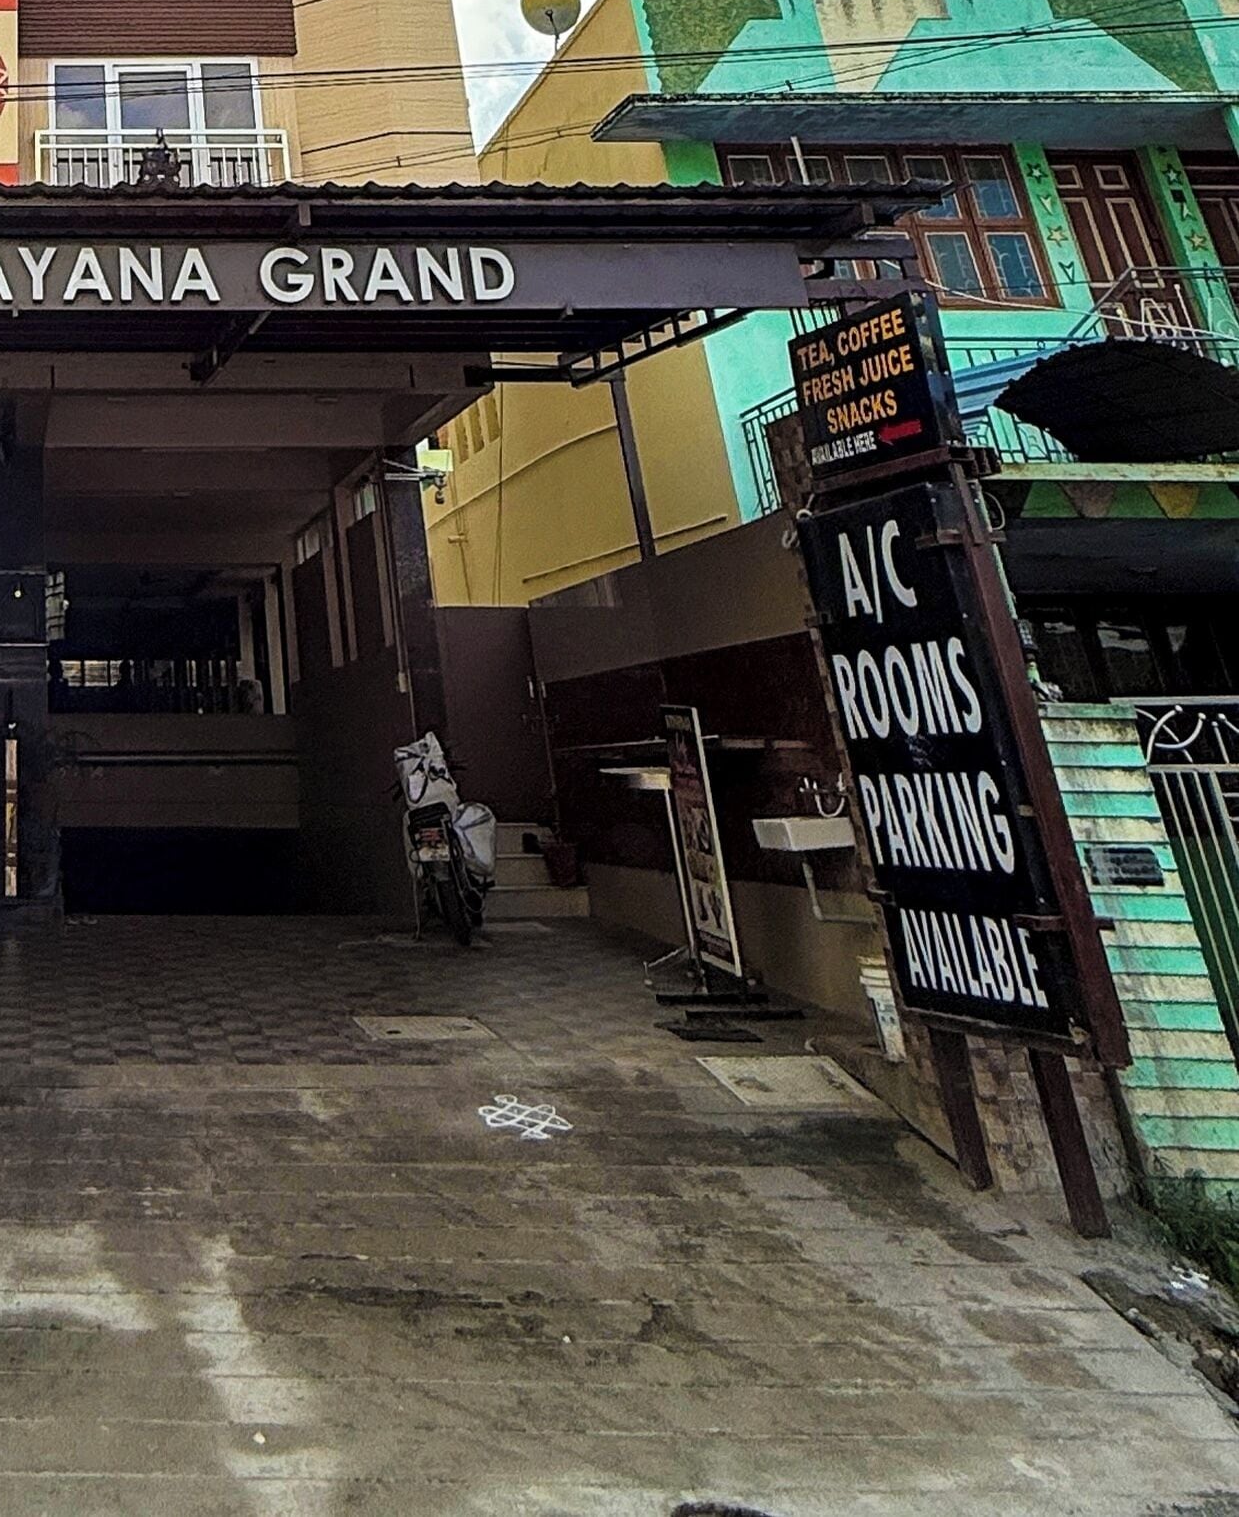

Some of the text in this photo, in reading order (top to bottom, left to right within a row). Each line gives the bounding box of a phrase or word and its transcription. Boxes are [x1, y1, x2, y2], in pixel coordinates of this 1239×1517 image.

[260, 246, 516, 304] GRAND
[796, 308, 906, 372] TEA, COFFEE
[802, 344, 915, 406] FRESH JUICE
[826, 389, 898, 434] SNACKS
[811, 430, 878, 466] AVAILABLE HERE
[838, 519, 918, 624] A/C
[832, 636, 982, 740] ROOMS
[858, 770, 1015, 874] PARKING
[899, 907, 1049, 1009] AVAILABLE
